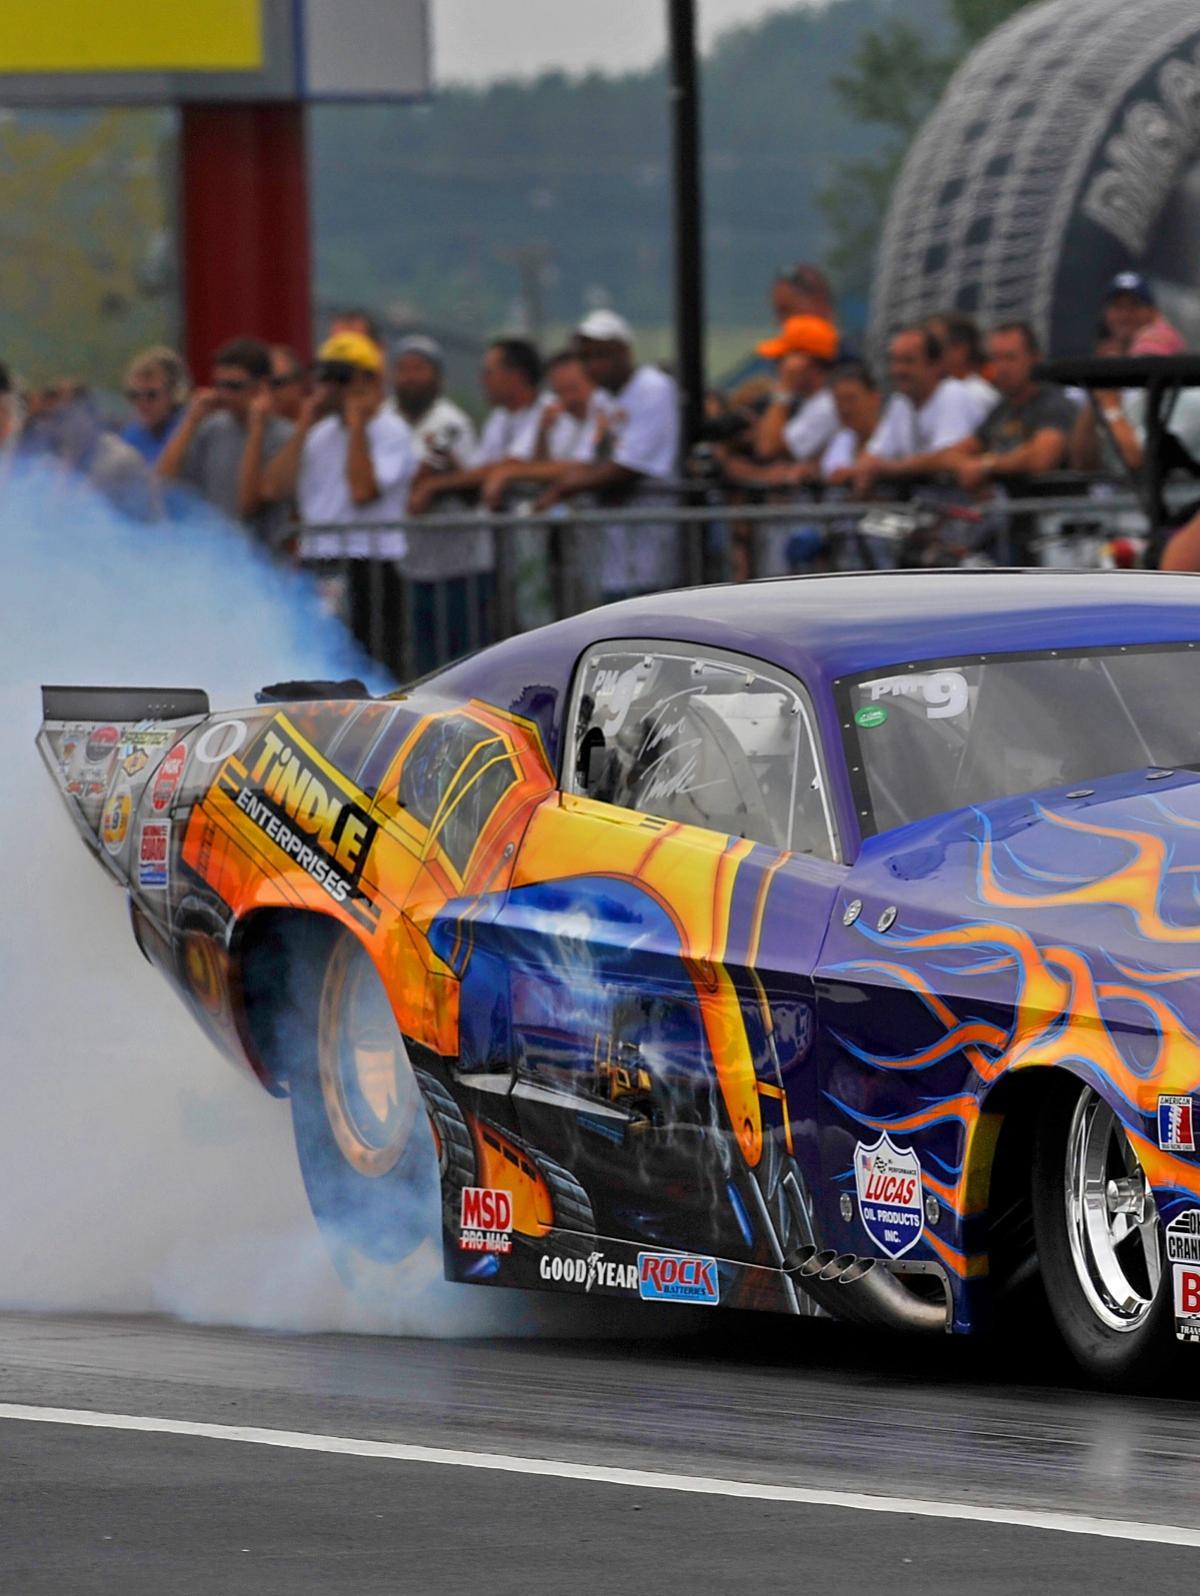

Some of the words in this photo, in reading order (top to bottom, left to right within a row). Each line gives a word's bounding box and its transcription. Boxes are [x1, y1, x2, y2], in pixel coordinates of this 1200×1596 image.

[923, 672, 969, 719] 9
[236, 787, 352, 902] ENTERPRISES
[865, 1174, 916, 1205] LUCAS
[463, 1189, 511, 1230] MSD
[863, 1207, 876, 1221] OIL
[877, 1209, 920, 1227] PRODUCTS
[462, 1230, 484, 1249] PRO
[884, 1229, 902, 1242] INC.
[642, 1257, 714, 1296] ROCK
[663, 1285, 706, 1295] BATTERIES
